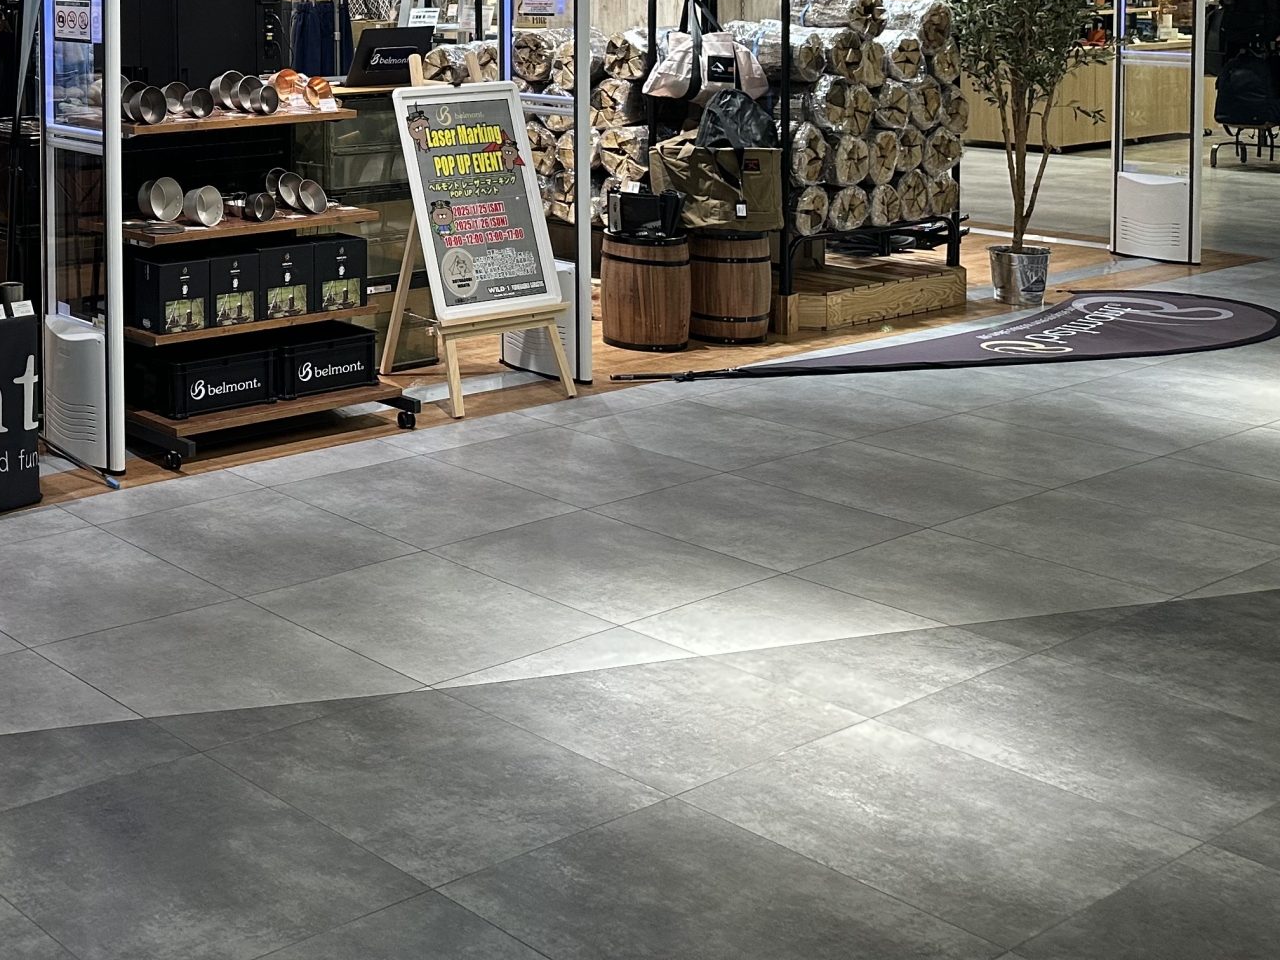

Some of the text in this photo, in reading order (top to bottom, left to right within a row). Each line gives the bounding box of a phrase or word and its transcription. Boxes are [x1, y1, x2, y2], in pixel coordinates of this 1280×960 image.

[425, 122, 503, 148] Laser Marking
[433, 151, 504, 177] POP UP EVENT
[450, 189, 463, 198] POP
[18, 448, 39, 471] fun
